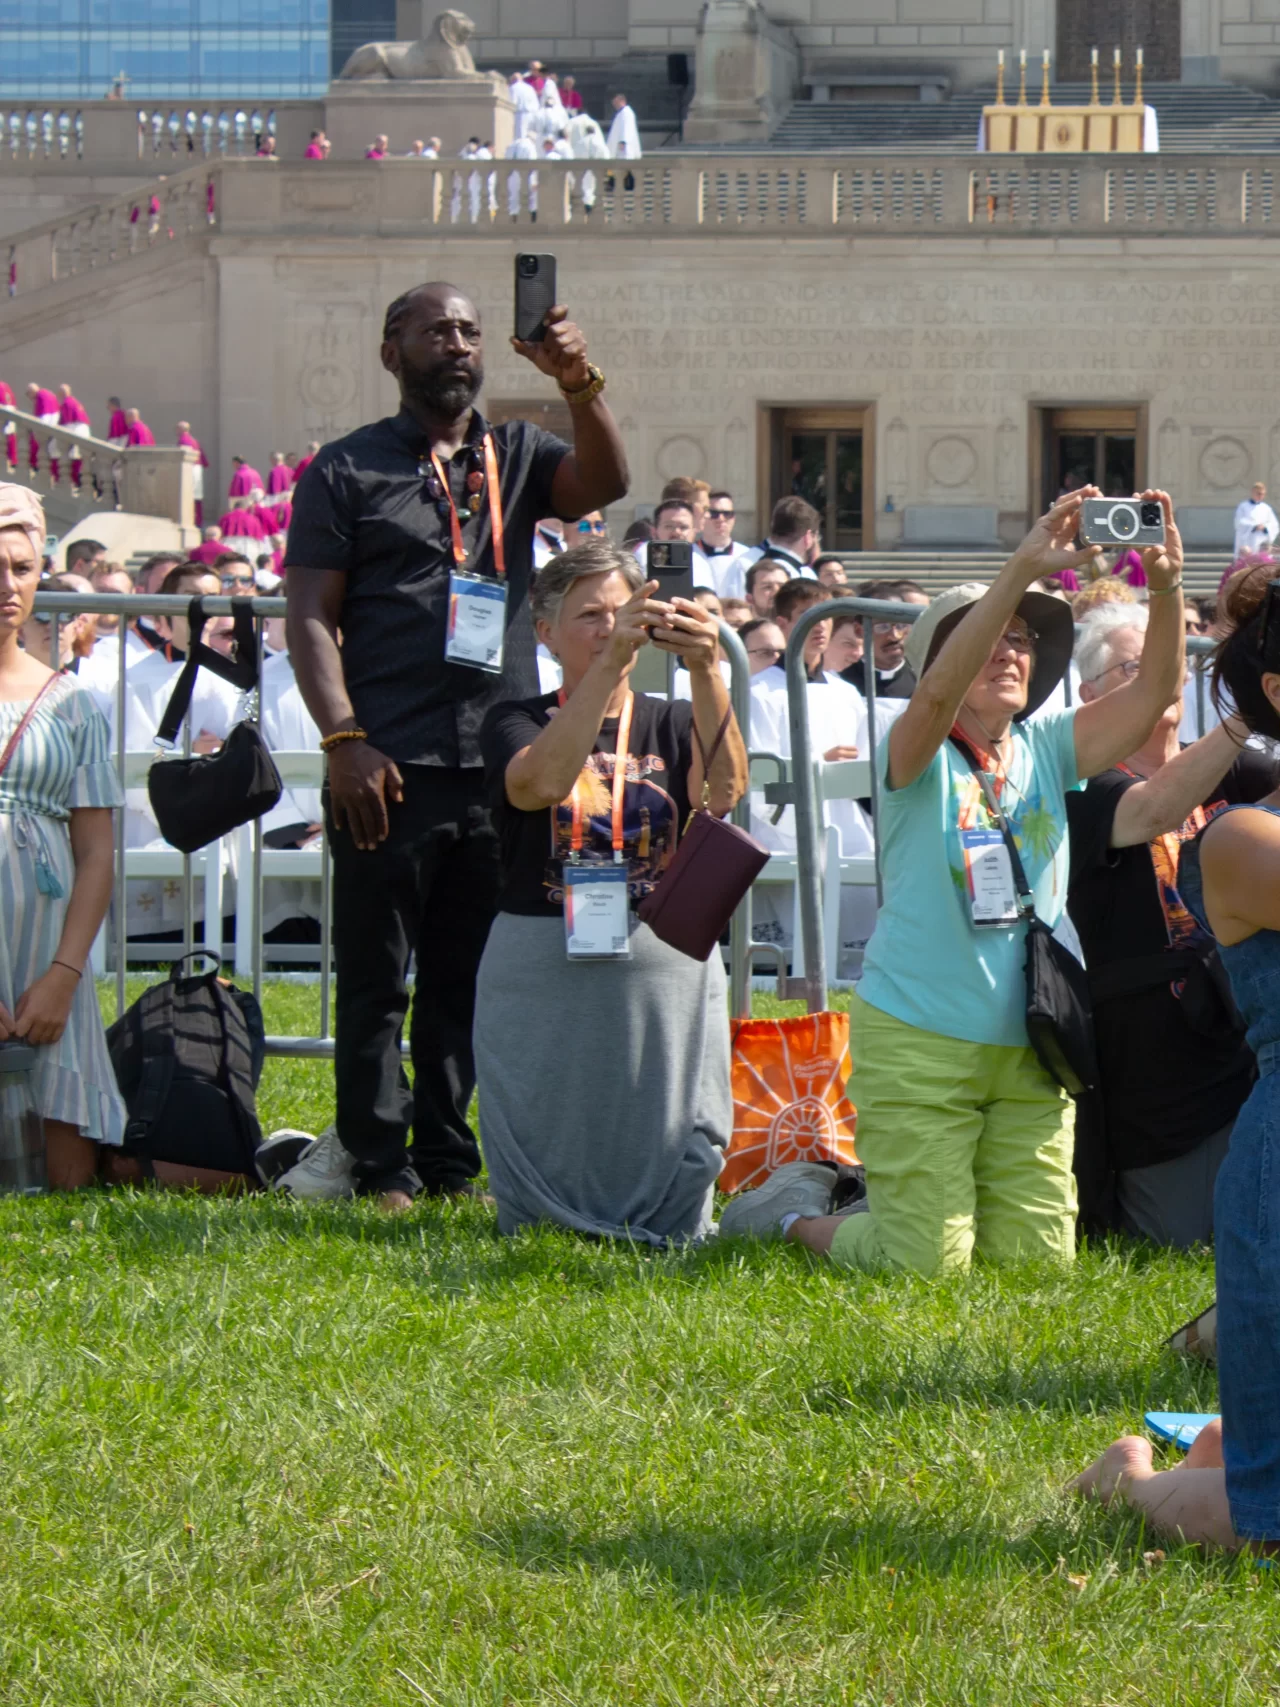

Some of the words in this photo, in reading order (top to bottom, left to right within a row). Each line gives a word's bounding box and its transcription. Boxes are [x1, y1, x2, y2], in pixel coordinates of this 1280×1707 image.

[653, 283, 695, 302] THE
[932, 283, 961, 302] OF
[967, 283, 1012, 302] THE
[1082, 283, 1120, 302] SEA
[1126, 283, 1171, 302] AND
[1174, 283, 1211, 302] AIR
[575, 307, 613, 325] ALL
[617, 307, 663, 325] WHO
[871, 307, 917, 325] AND
[921, 307, 986, 325] LOYAL
[1166, 307, 1214, 325] AND
[659, 329, 674, 347] A
[676, 329, 732, 347] TRUE
[738, 329, 915, 347] UNDERSTANDING
[919, 329, 966, 347] AND
[1121, 329, 1152, 347] OF
[1157, 329, 1200, 347] THE
[600, 351, 629, 369] TO
[636, 351, 716, 369] INSPIRE
[725, 351, 852, 369] PATRIOTISM
[863, 351, 913, 369] AND
[923, 351, 1015, 369] RESPECT
[1027, 351, 1070, 369] FOR
[1075, 351, 1120, 369] THE
[1182, 351, 1215, 369] TO
[1218, 351, 1265, 369] THE
[1041, 374, 1171, 392] MAINTAINED
[1179, 374, 1222, 392] AND
